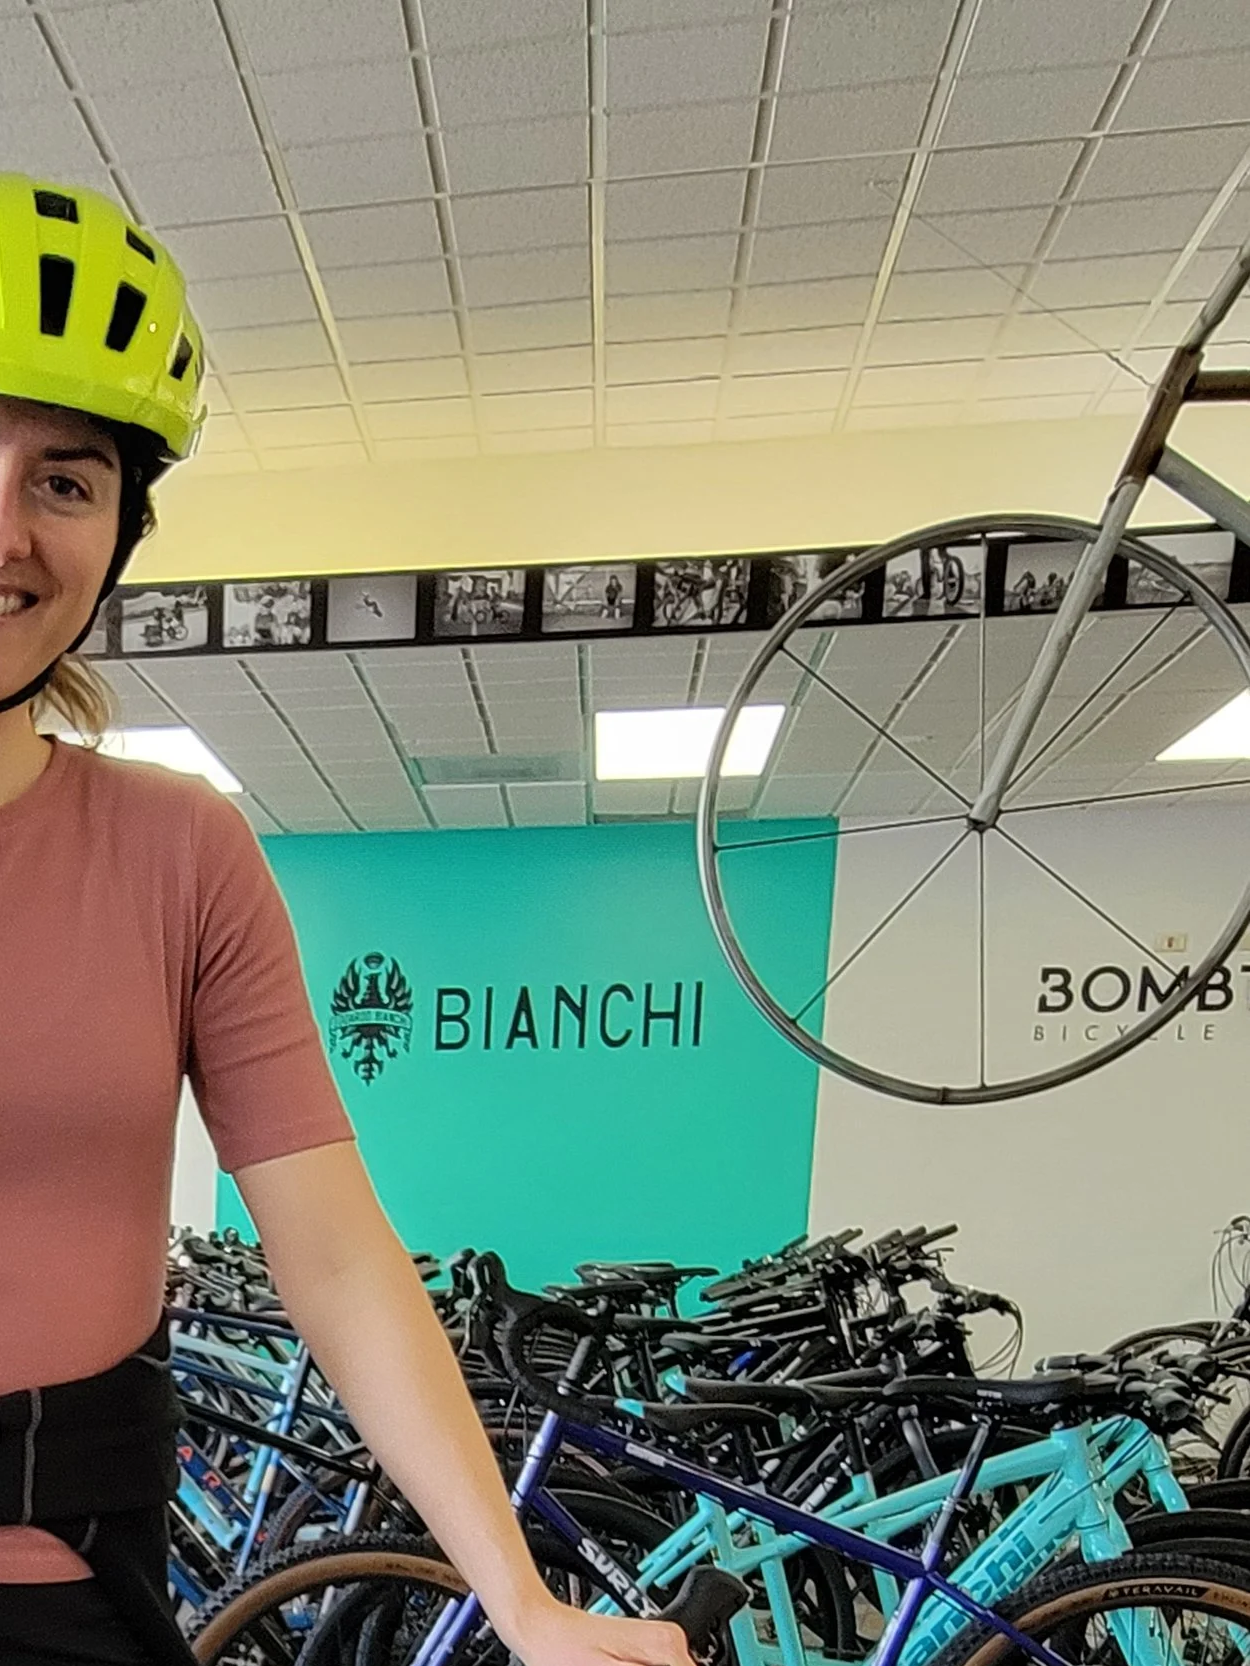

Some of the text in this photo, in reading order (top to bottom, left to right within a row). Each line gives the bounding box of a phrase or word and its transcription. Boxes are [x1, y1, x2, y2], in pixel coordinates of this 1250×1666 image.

[434, 981, 703, 1051] BIANCHI
[1037, 965, 1250, 1013] BOMB
[1033, 1023, 1215, 1042] BICYLE
[578, 1537, 662, 1618] SURLY
